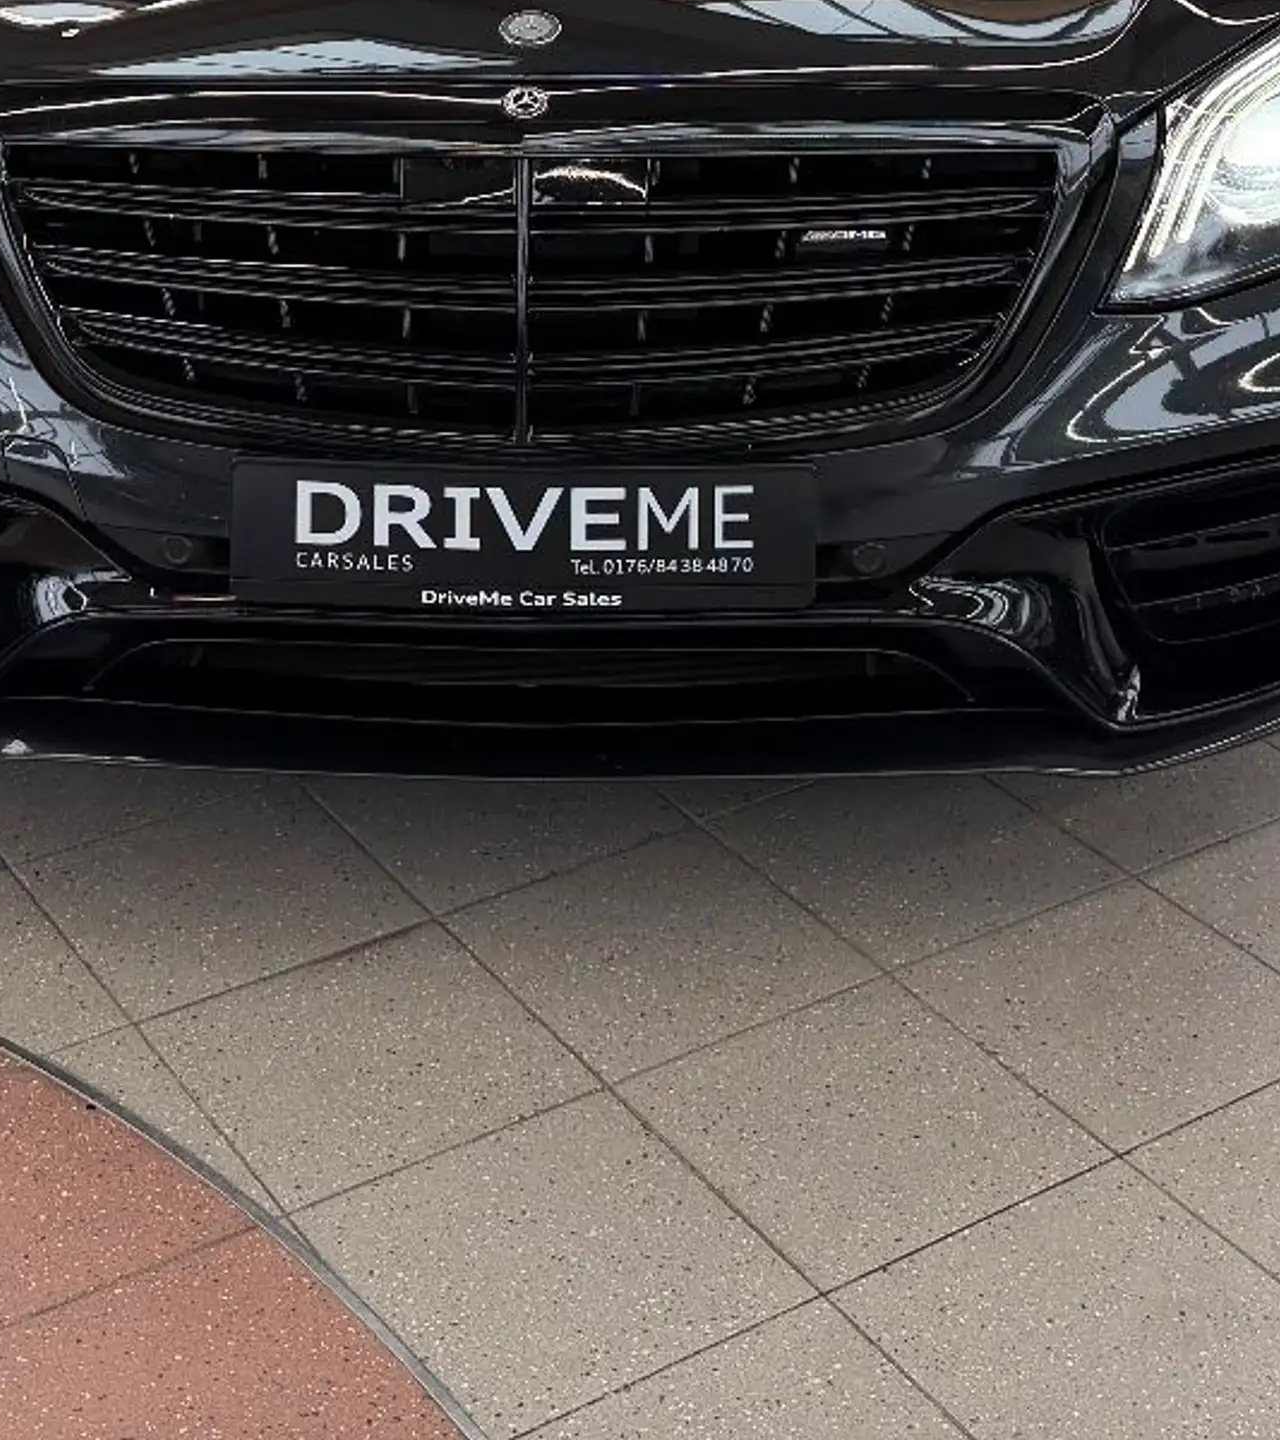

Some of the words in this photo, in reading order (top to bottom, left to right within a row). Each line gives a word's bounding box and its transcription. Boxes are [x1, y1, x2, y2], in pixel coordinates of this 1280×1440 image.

[295, 479, 755, 551] DRIVEME
[295, 551, 414, 572] CARSALES
[421, 590, 513, 606] DriveMe
[519, 591, 557, 607] Car
[562, 591, 623, 607] Sales
